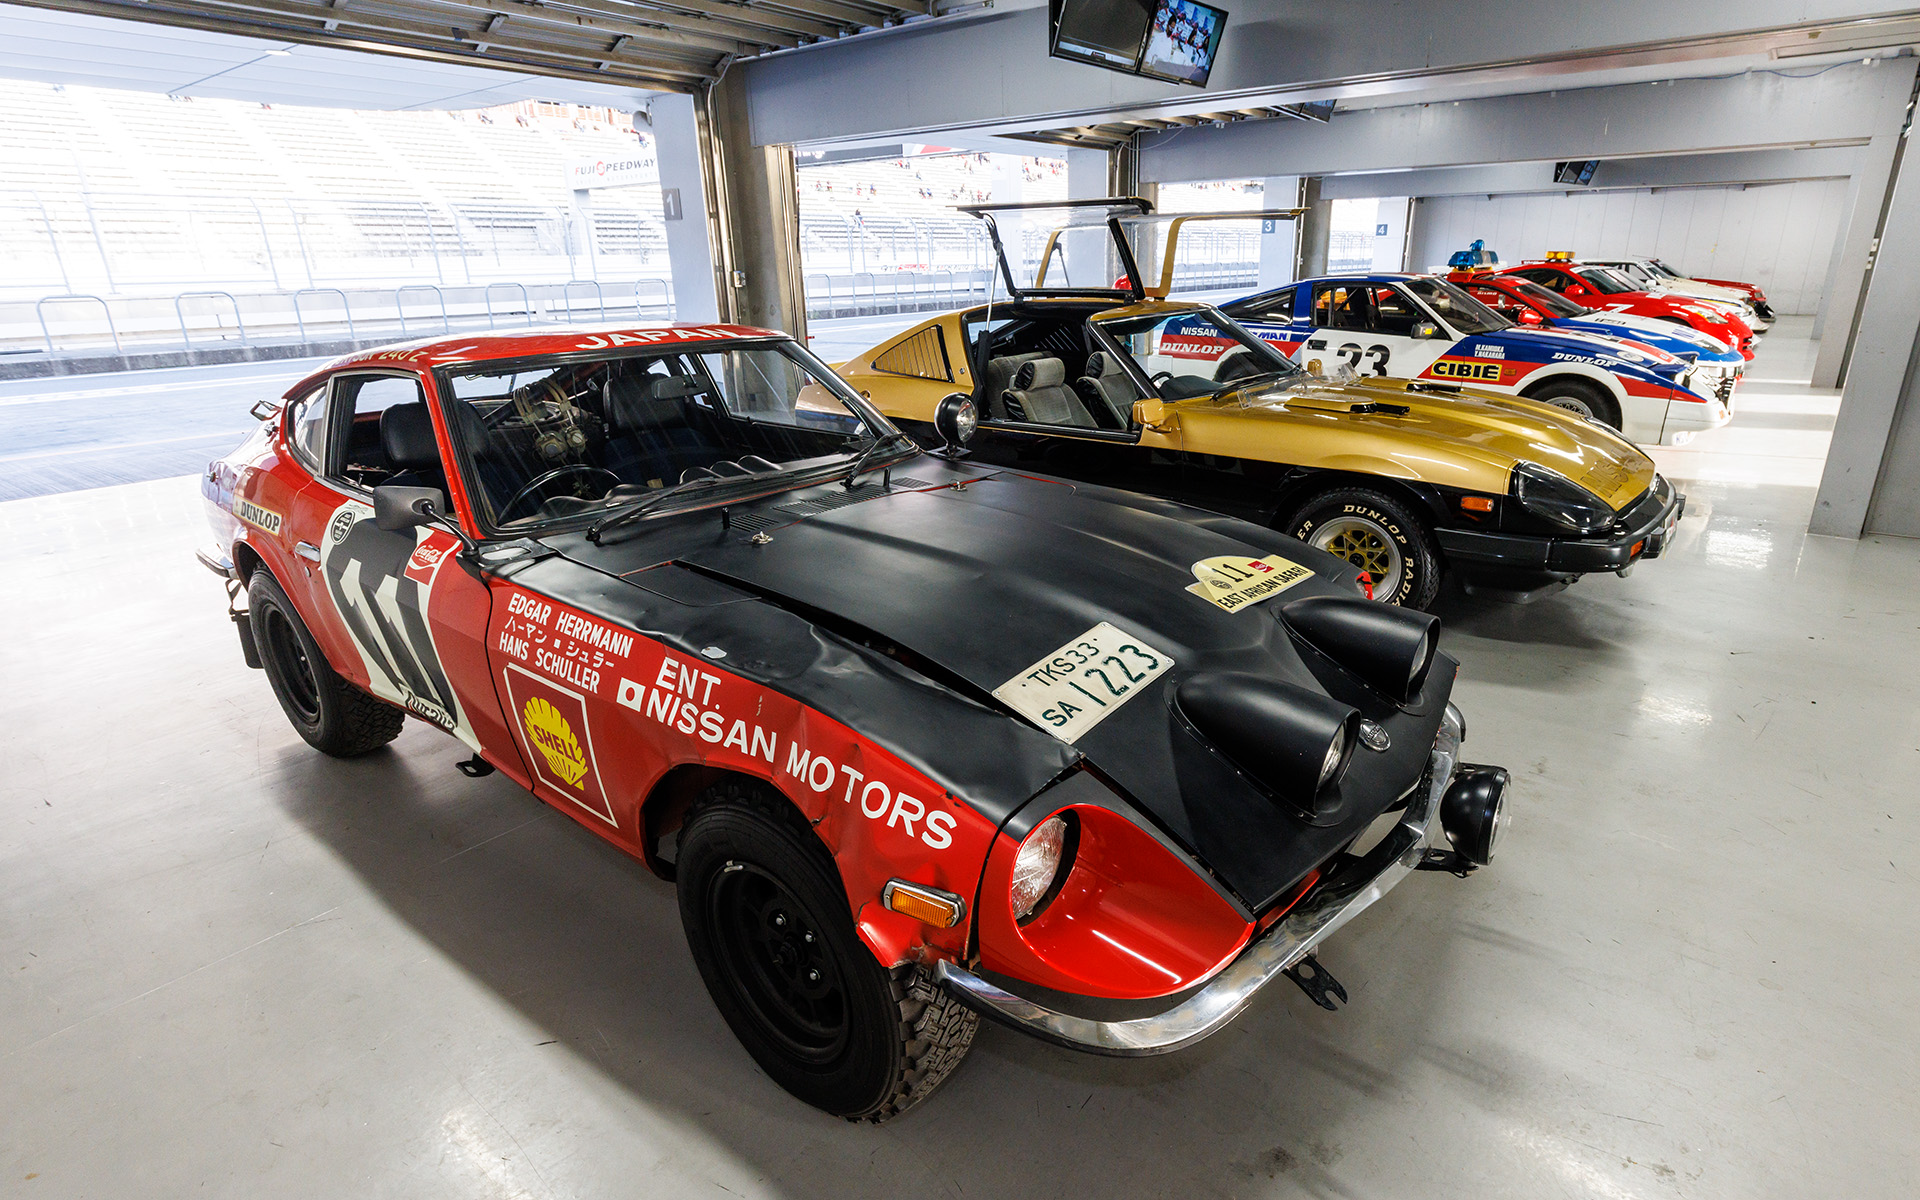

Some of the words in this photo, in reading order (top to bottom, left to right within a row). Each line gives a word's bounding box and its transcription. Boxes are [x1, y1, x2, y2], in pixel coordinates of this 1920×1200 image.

[666, 193, 675, 216] 1
[1264, 220, 1272, 232] 3
[1378, 226, 1385, 235] 4
[575, 327, 740, 350] JAPAN
[1160, 342, 1225, 355] DUNLOP
[1180, 326, 1218, 338] NISSAN
[1336, 343, 1391, 377] 23
[1551, 352, 1620, 368] DUNLOP
[240, 501, 280, 532] DUNLOP
[1343, 504, 1407, 545] DUNLOP
[1211, 563, 1255, 583] 11
[1216, 592, 1248, 609] EAST
[1240, 578, 1282, 599] AFRICAN
[1276, 565, 1309, 584] SAFARI
[339, 557, 445, 705] 11
[507, 592, 552, 626] EDGAR
[555, 611, 634, 659] HERRMANN
[499, 631, 530, 661] HANS
[535, 647, 601, 694] SCHULLER
[655, 656, 721, 711] ENT.
[1041, 700, 1083, 727] SA
[1068, 644, 1159, 707] 1223
[532, 723, 581, 765] SHELL
[646, 688, 777, 763] NISSAN
[786, 740, 957, 850] MOTORS
